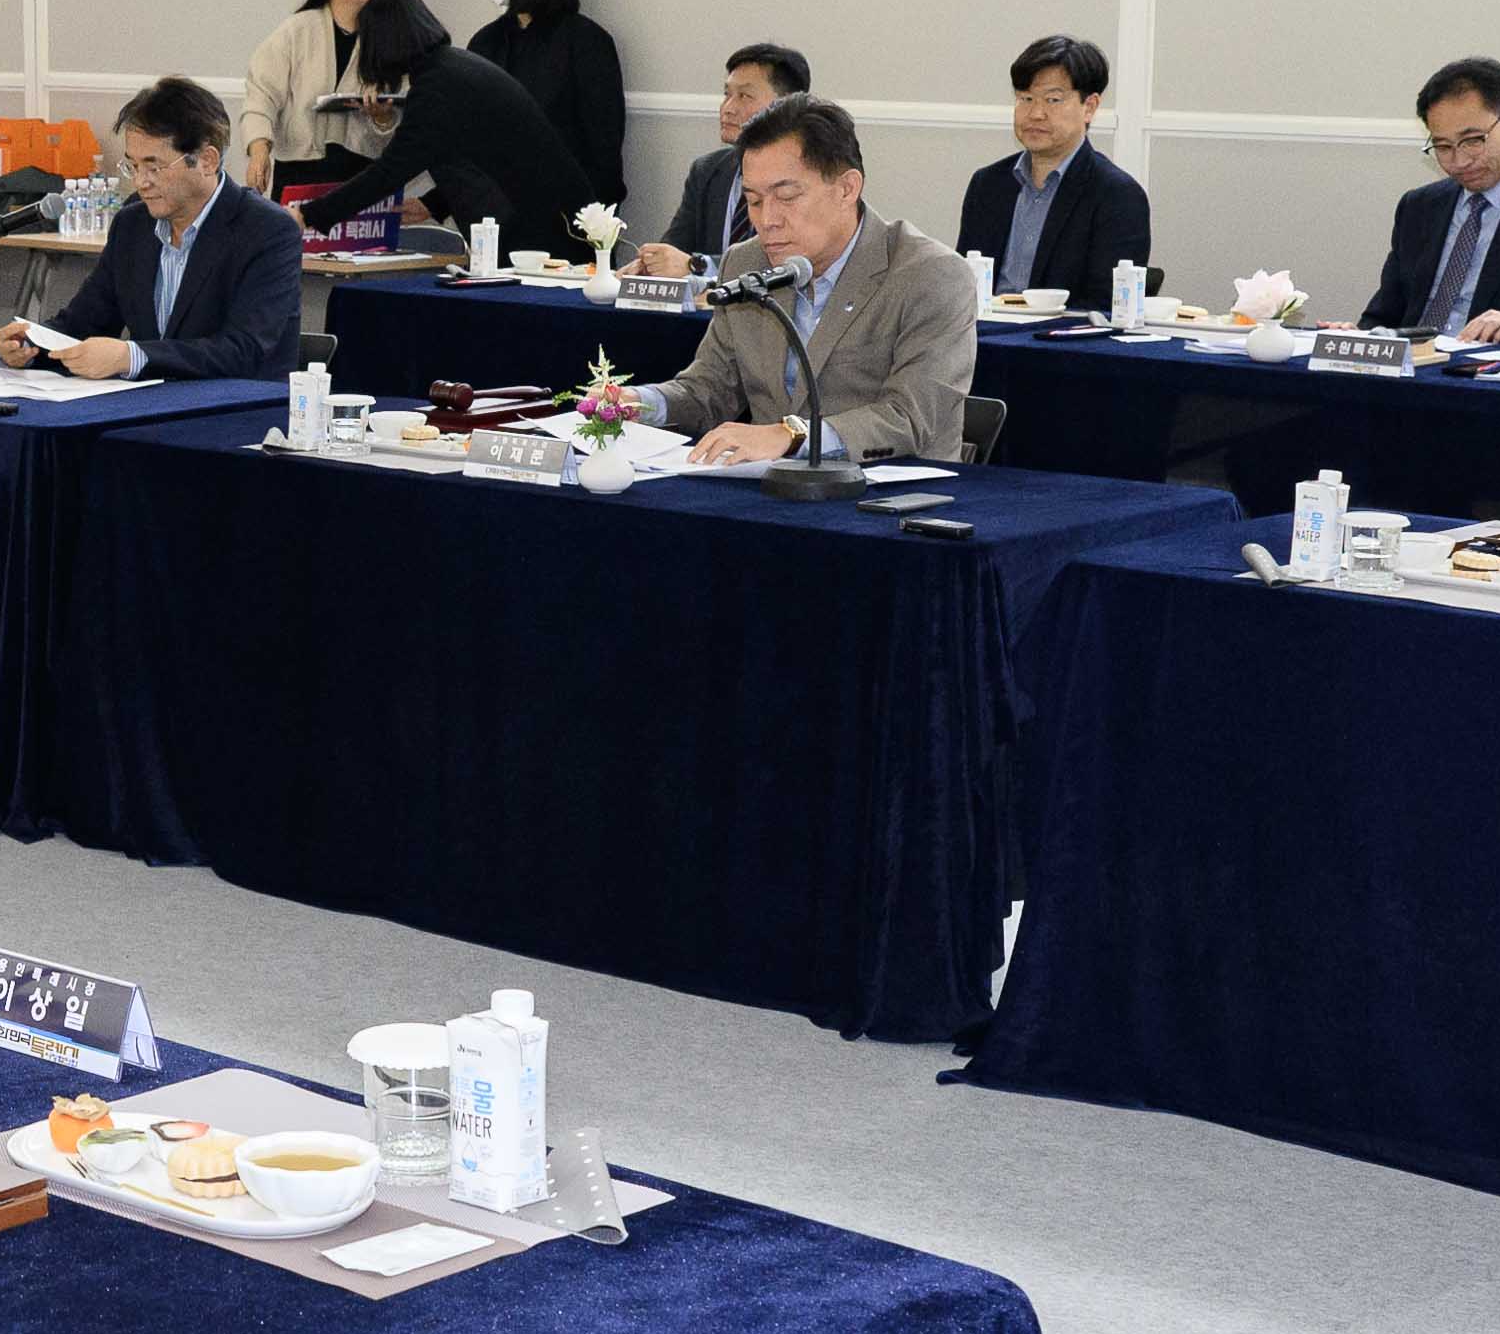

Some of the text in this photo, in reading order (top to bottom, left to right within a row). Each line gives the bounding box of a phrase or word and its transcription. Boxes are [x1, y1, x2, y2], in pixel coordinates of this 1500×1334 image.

[345, 219, 386, 240] 특례시
[627, 282, 679, 298] 고양특례시
[1324, 339, 1396, 359] 수원특례시
[472, 1079, 496, 1115] 물
